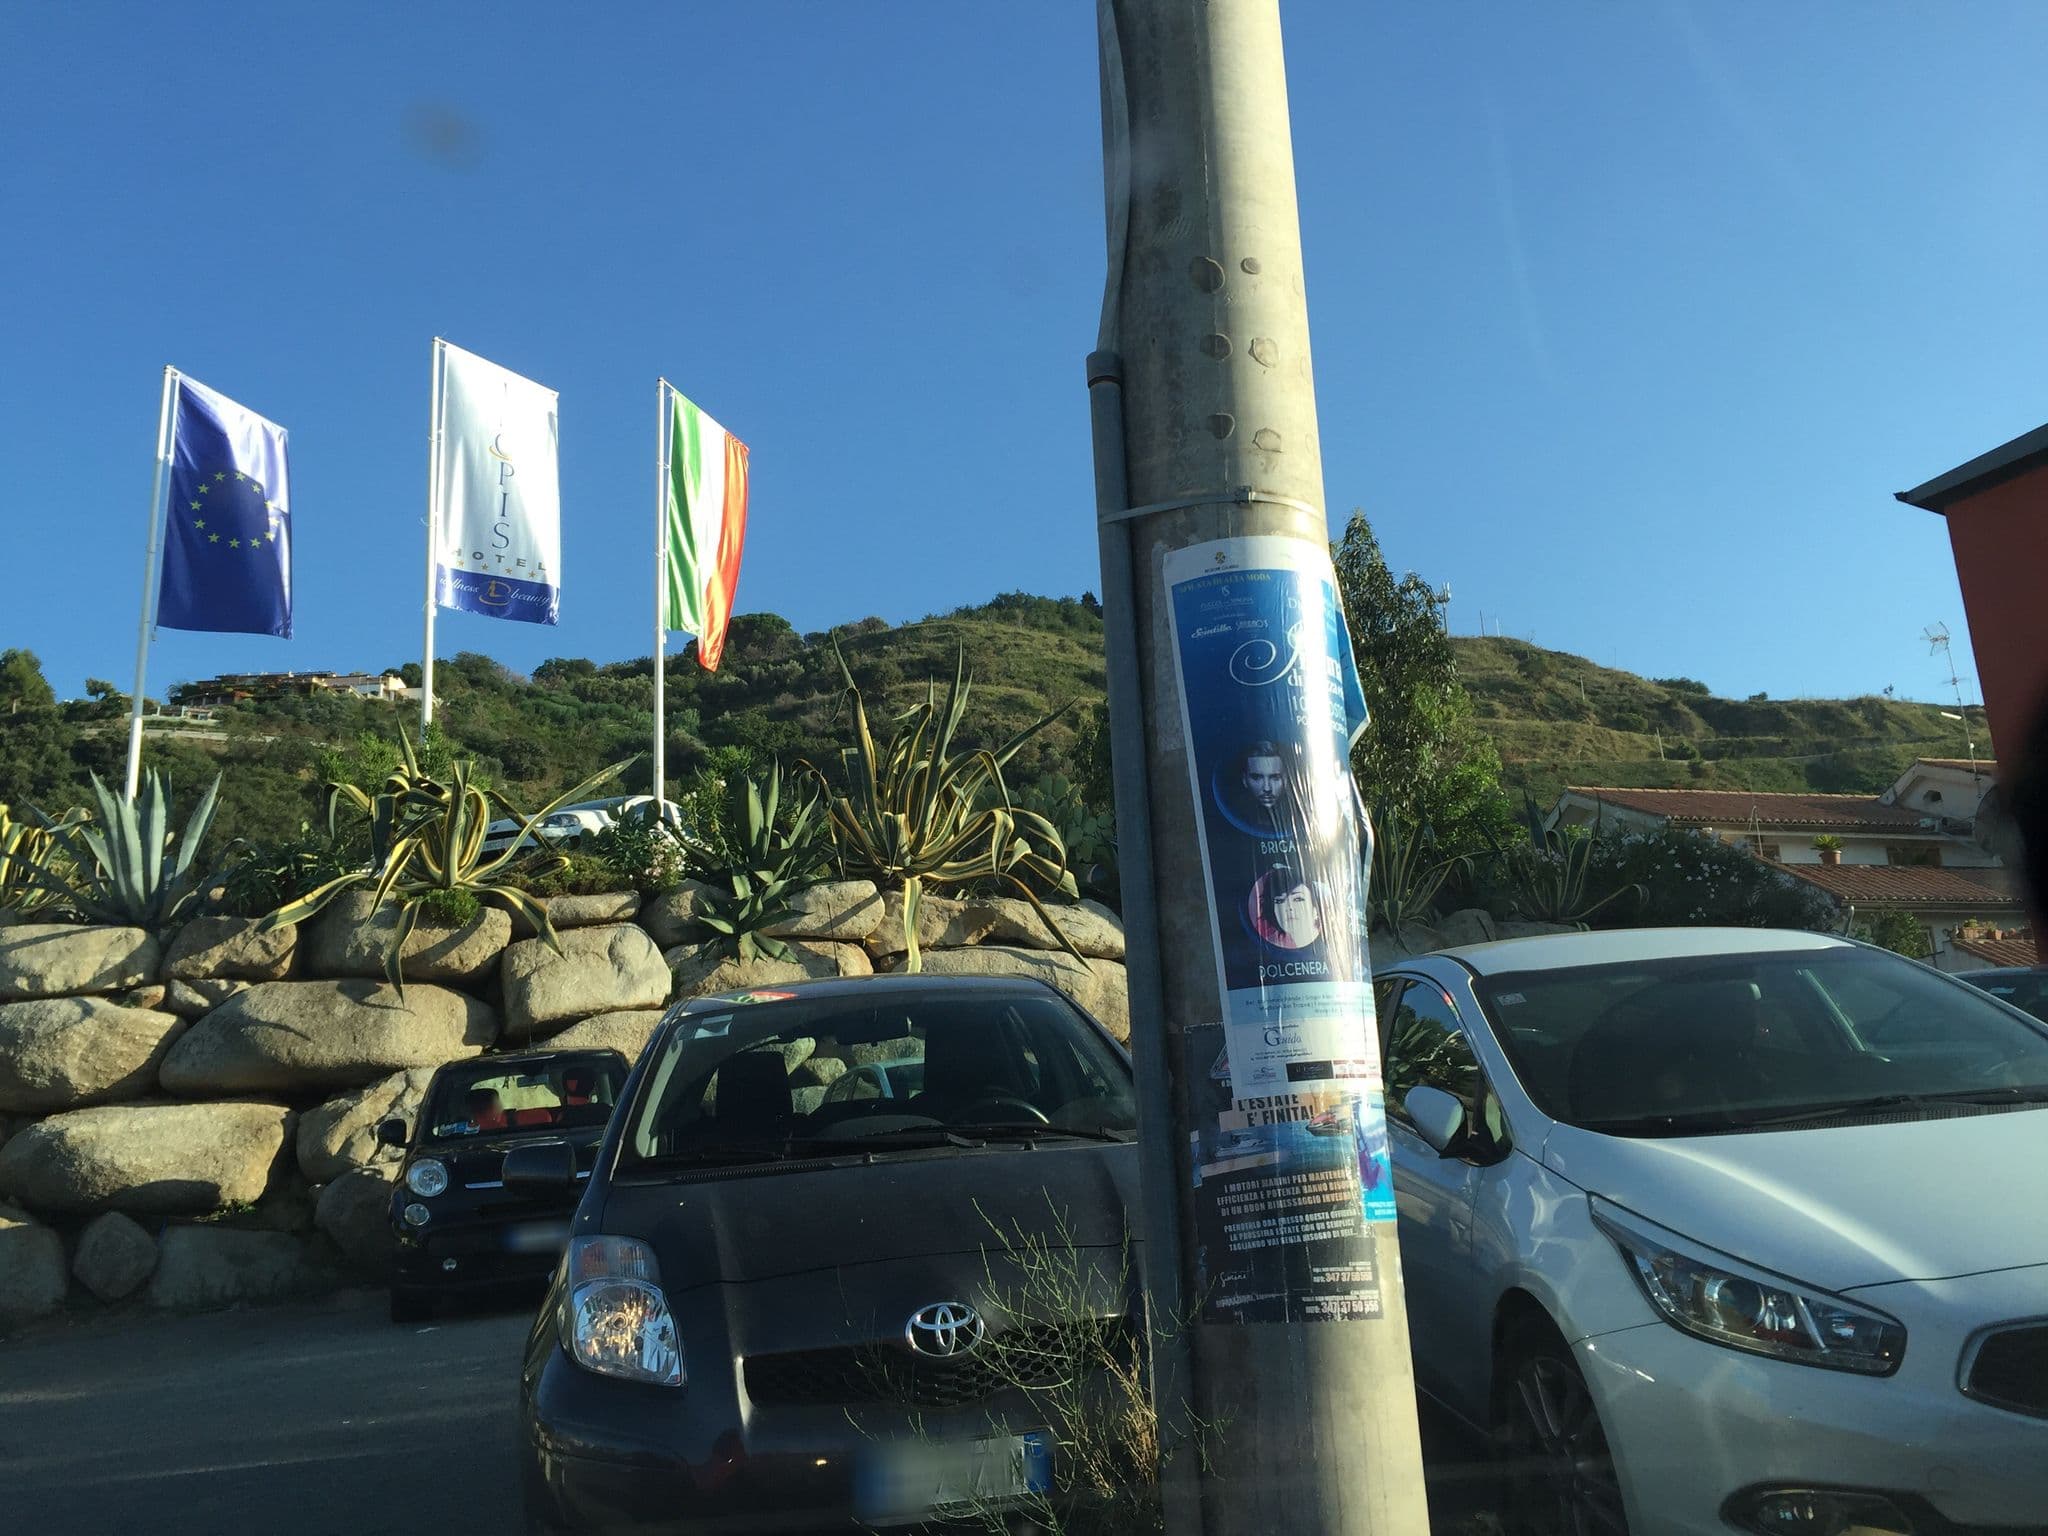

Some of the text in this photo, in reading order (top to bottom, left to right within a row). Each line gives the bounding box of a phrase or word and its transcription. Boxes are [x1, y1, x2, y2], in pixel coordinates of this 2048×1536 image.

[1259, 961, 1330, 978] DOLCENERA
[1262, 1105, 1314, 1125] FINITA!
[1230, 1180, 1260, 1192] MOTORI
[1216, 1192, 1258, 1206] EFFICIENZA
[1266, 1186, 1301, 1199] POTENZA
[1304, 1211, 1330, 1222] QUESTA
[1239, 1228, 1274, 1240] PROSSIMA
[1275, 1224, 1300, 1236] ESTATE
[1229, 1240, 1266, 1252] TAGLIANDO
[1340, 1272, 1350, 1282] 37
[1340, 1300, 1351, 1313] 37
[1352, 1300, 1363, 1312] 50
